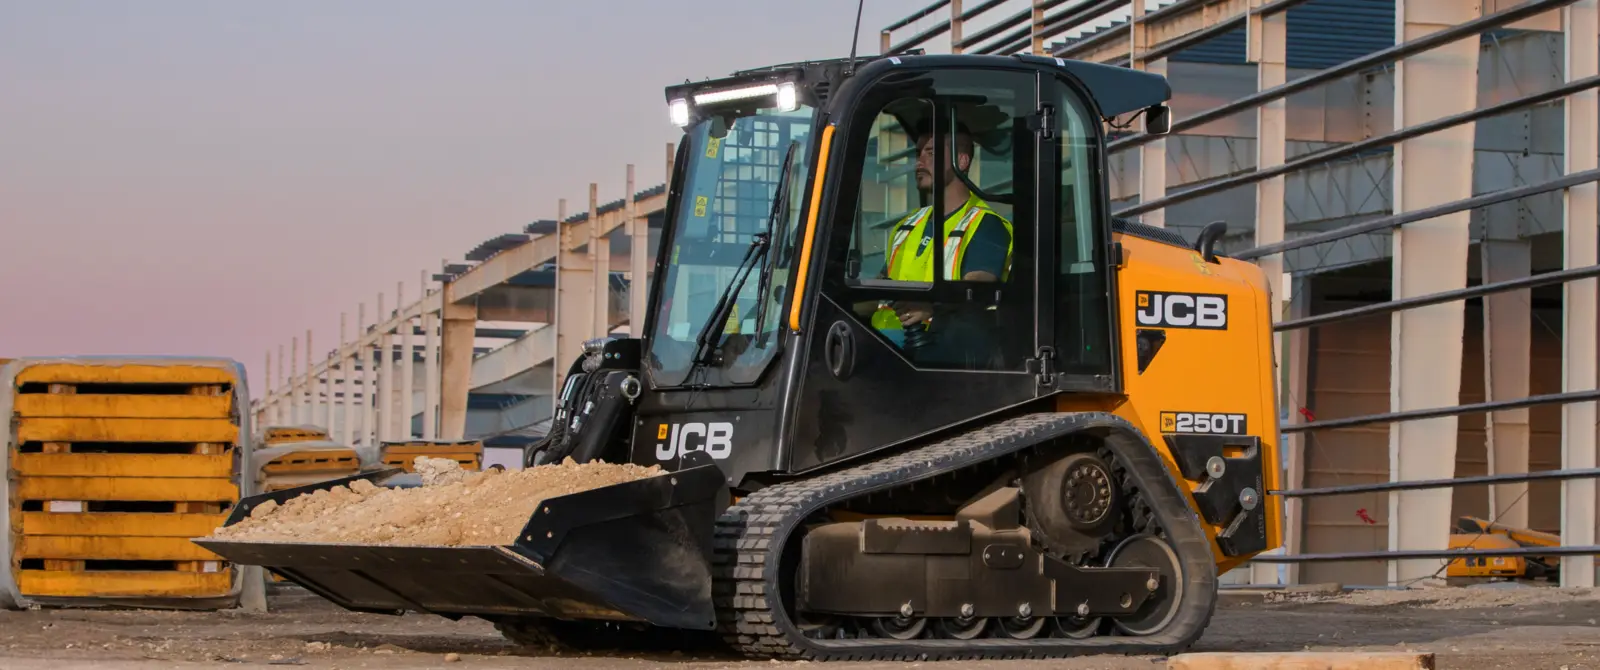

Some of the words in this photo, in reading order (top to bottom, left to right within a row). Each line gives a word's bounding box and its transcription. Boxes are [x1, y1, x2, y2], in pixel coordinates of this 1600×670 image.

[1138, 294, 1226, 327] JCB
[1176, 413, 1244, 433] 250T
[656, 422, 734, 461] JCB
